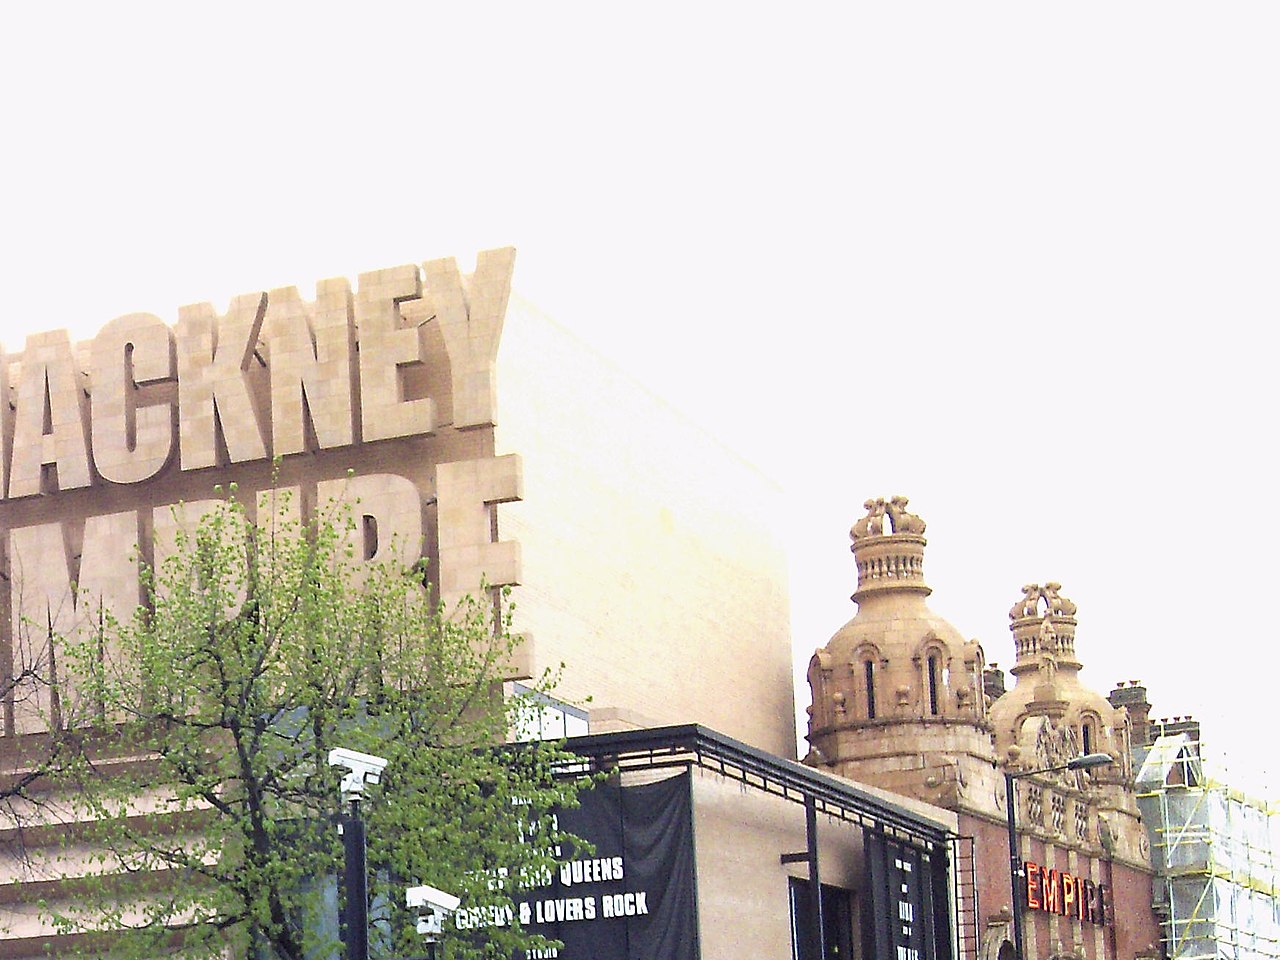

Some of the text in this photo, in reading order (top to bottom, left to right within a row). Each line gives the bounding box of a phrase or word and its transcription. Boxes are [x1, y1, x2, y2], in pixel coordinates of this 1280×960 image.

[560, 857, 624, 887] QUEENS
[536, 896, 596, 924] LOVERS
[602, 891, 648, 918] ROCK
[1024, 861, 1114, 927] EMPIRE
